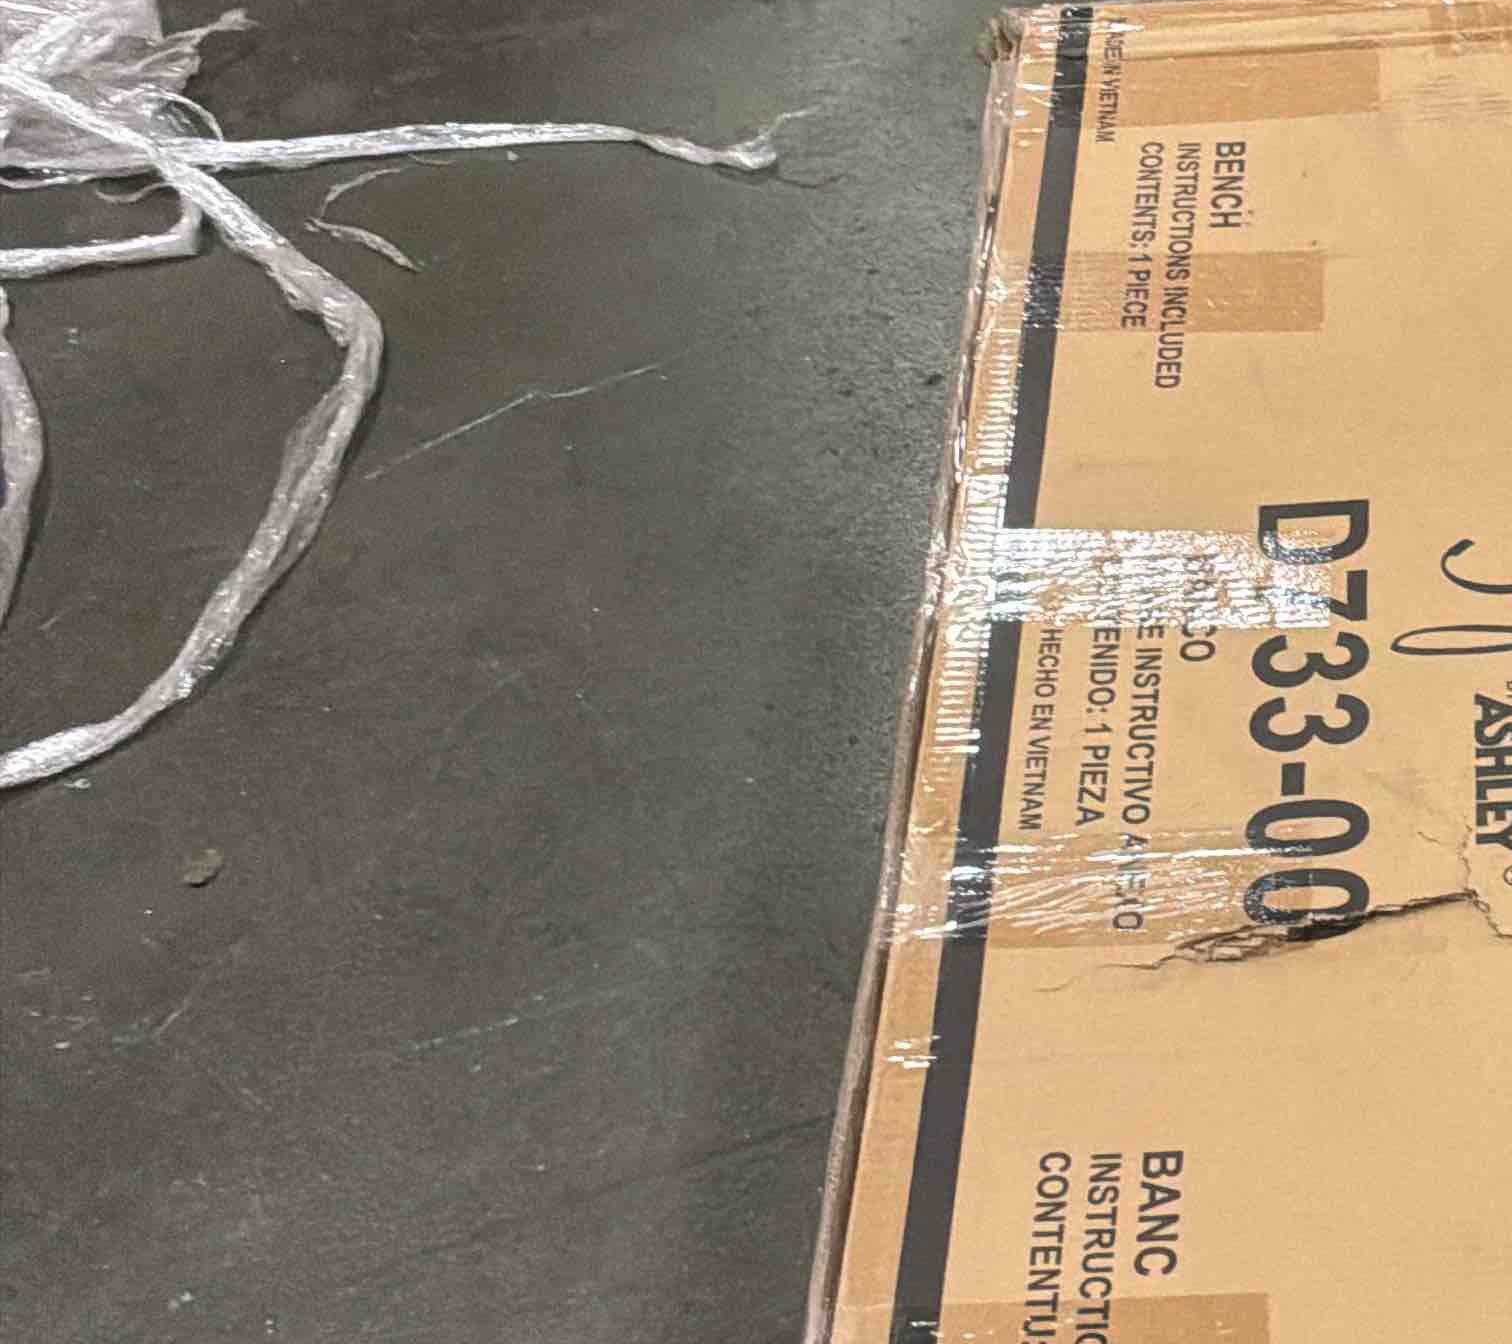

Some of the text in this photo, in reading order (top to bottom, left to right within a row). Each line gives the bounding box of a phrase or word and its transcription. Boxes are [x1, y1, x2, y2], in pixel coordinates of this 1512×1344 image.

[1095, 78, 1121, 143] VIETNAM
[1209, 141, 1246, 229] BENCH
[1120, 271, 1151, 329] PIECE
[1128, 253, 1151, 269] 1
[1154, 143, 1201, 390] INSTRUCTIONS INCLUDED
[1016, 627, 1064, 832] HECHO EN VIETNAM
[1084, 723, 1114, 735] 1
[1118, 644, 1164, 826] INSTRUCTIVO
[1242, 498, 1370, 925] D733-00
[1075, 740, 1111, 828] PIEZA
[1133, 1148, 1185, 1278] BANC
